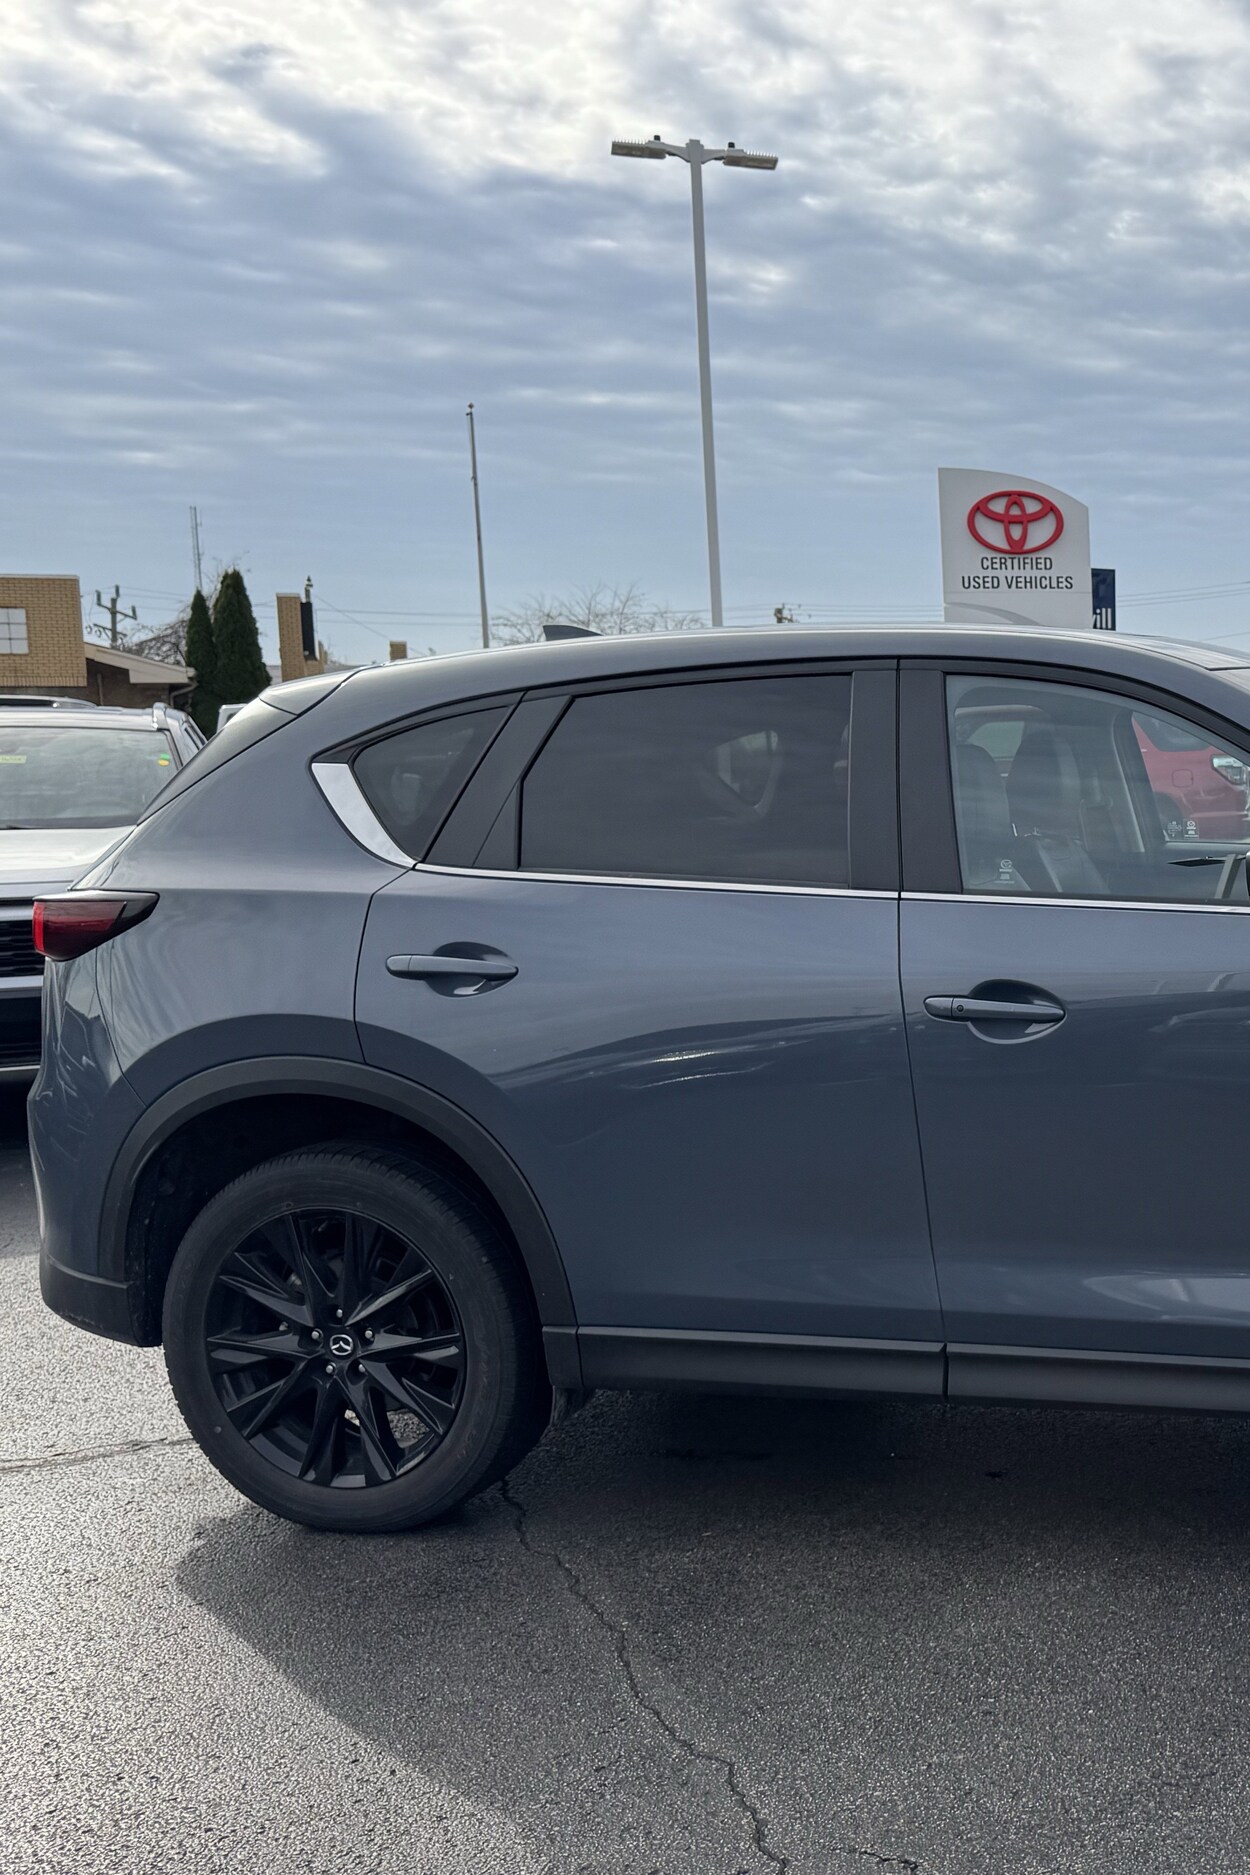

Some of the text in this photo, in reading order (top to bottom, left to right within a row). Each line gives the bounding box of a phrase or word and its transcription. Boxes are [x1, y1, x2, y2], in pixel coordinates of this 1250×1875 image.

[980, 556, 1053, 571] CERTIFIED
[961, 576, 1074, 590] USED VEHICLES
